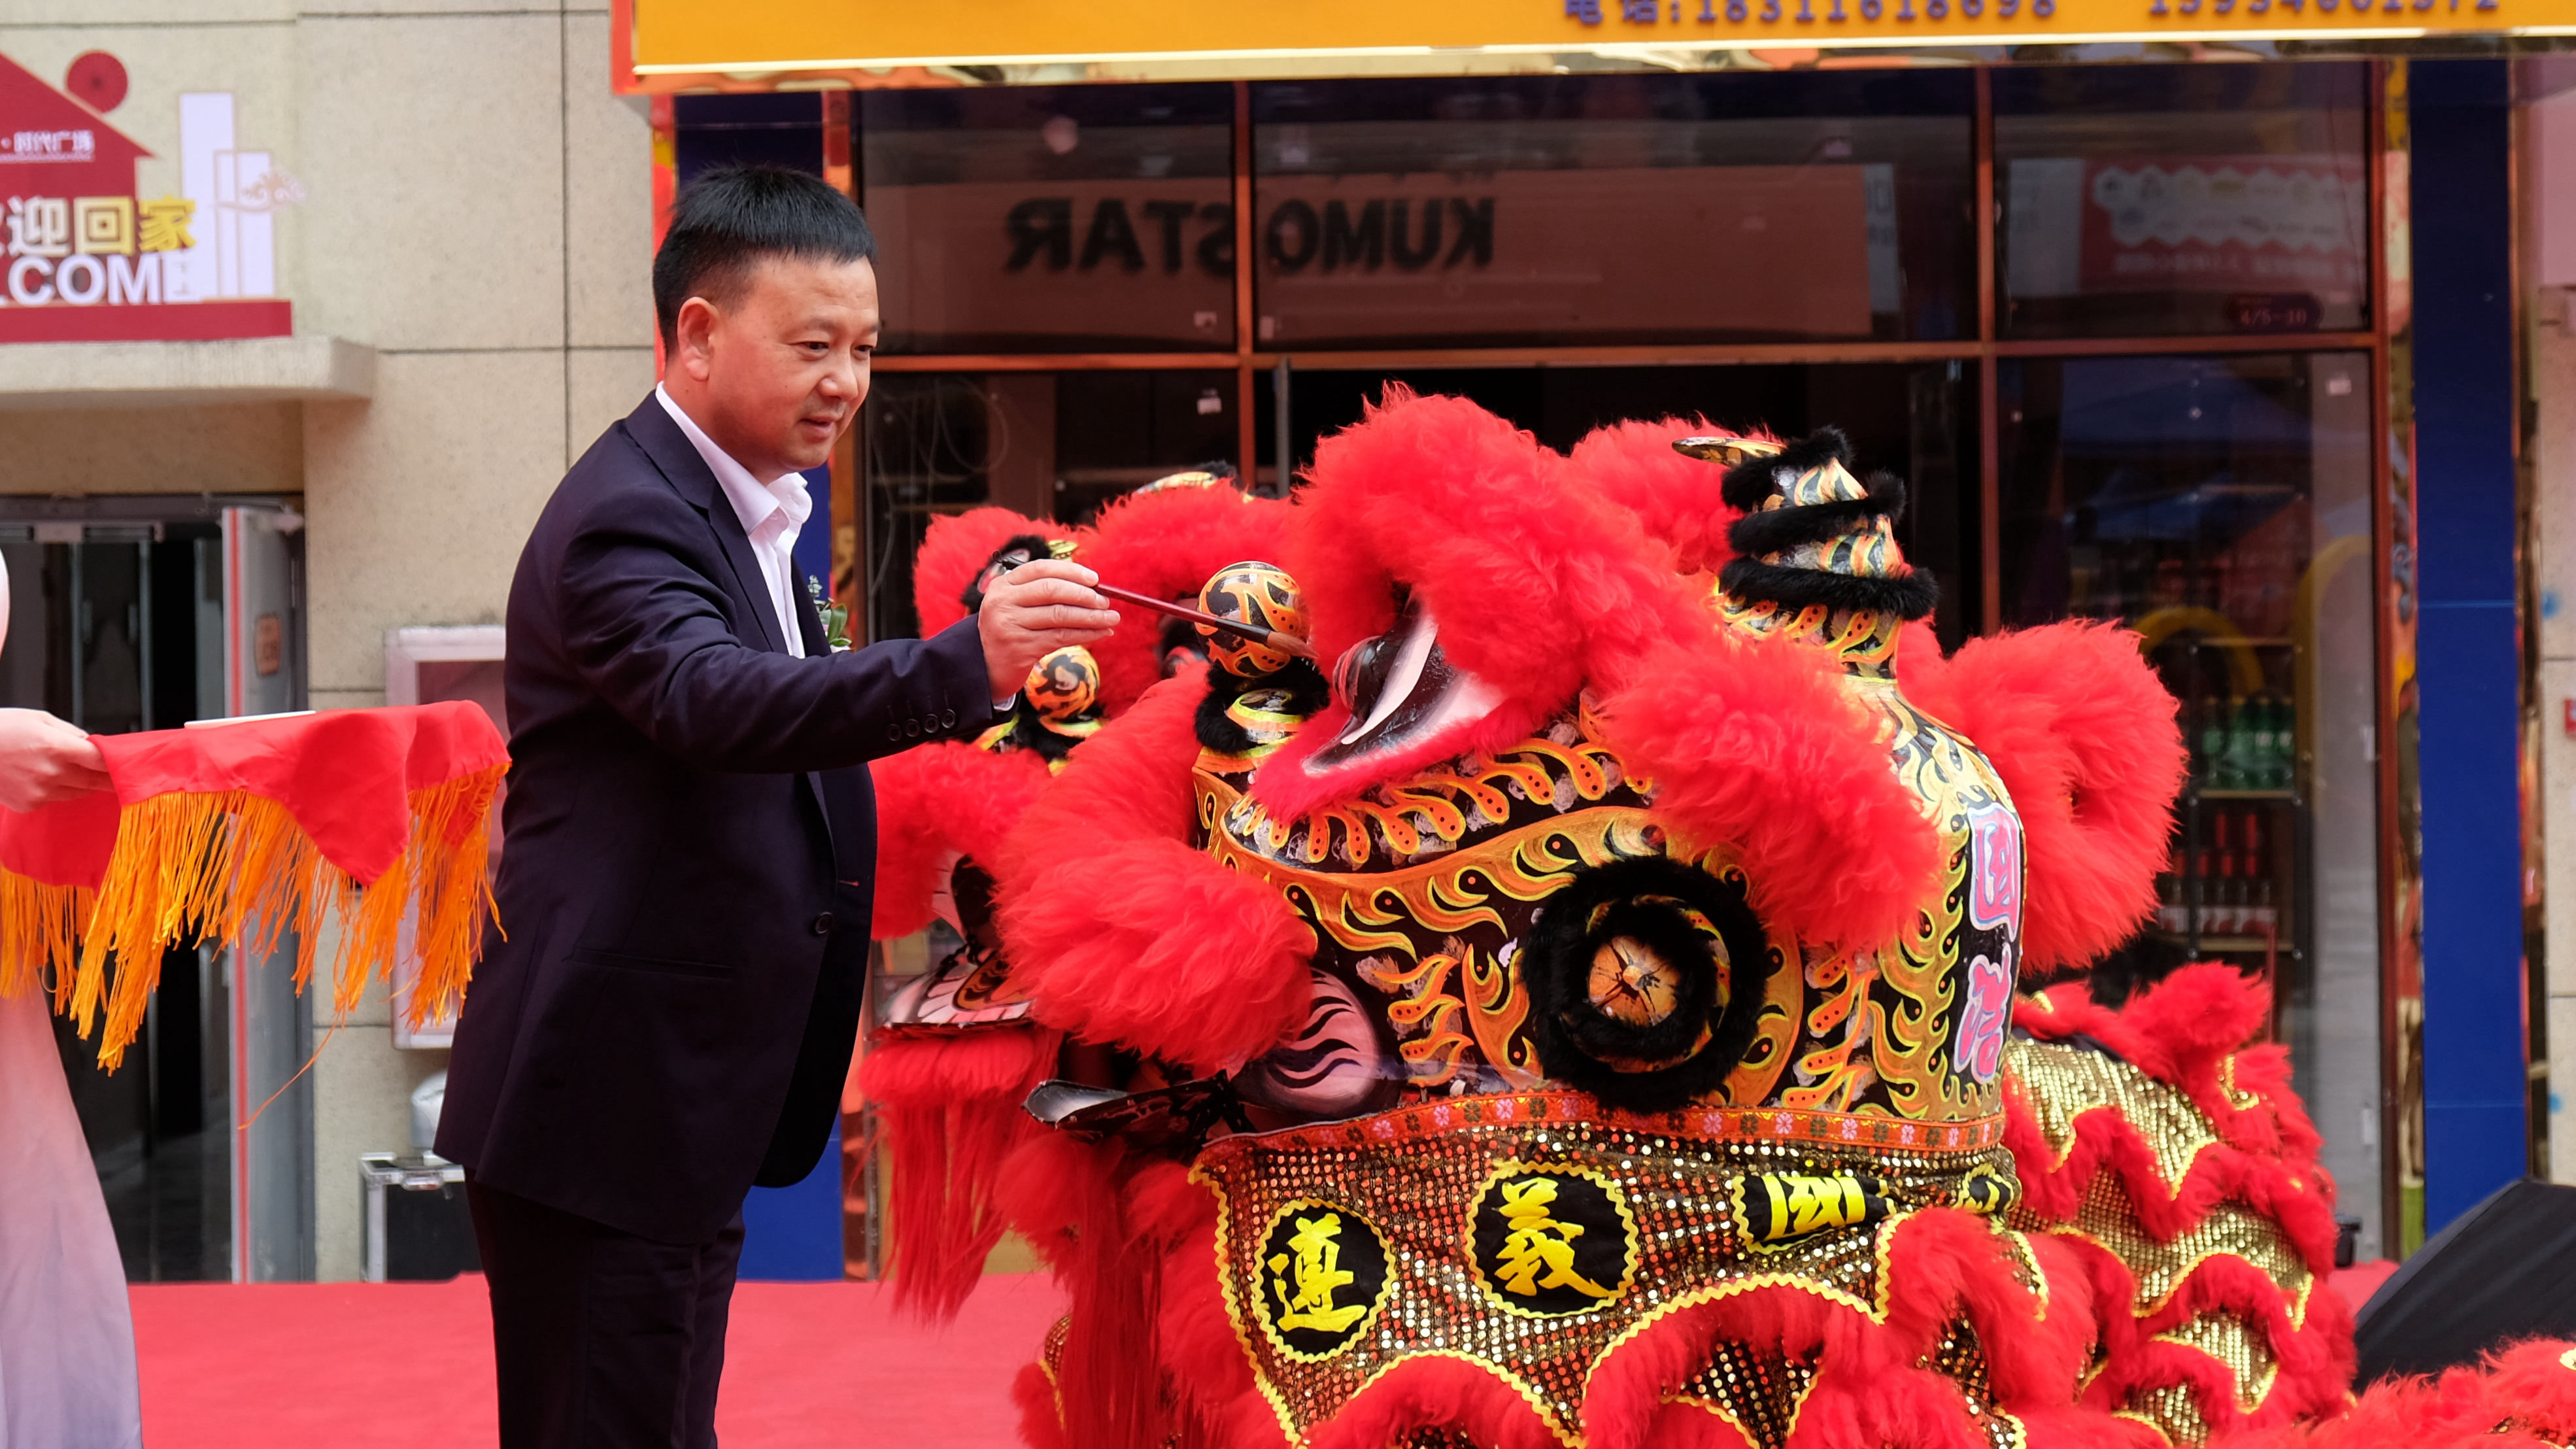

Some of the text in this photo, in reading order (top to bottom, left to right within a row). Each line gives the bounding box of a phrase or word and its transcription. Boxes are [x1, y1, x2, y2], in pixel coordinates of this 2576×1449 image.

[0, 195, 197, 256] 迎回家
[0, 252, 201, 306] COME
